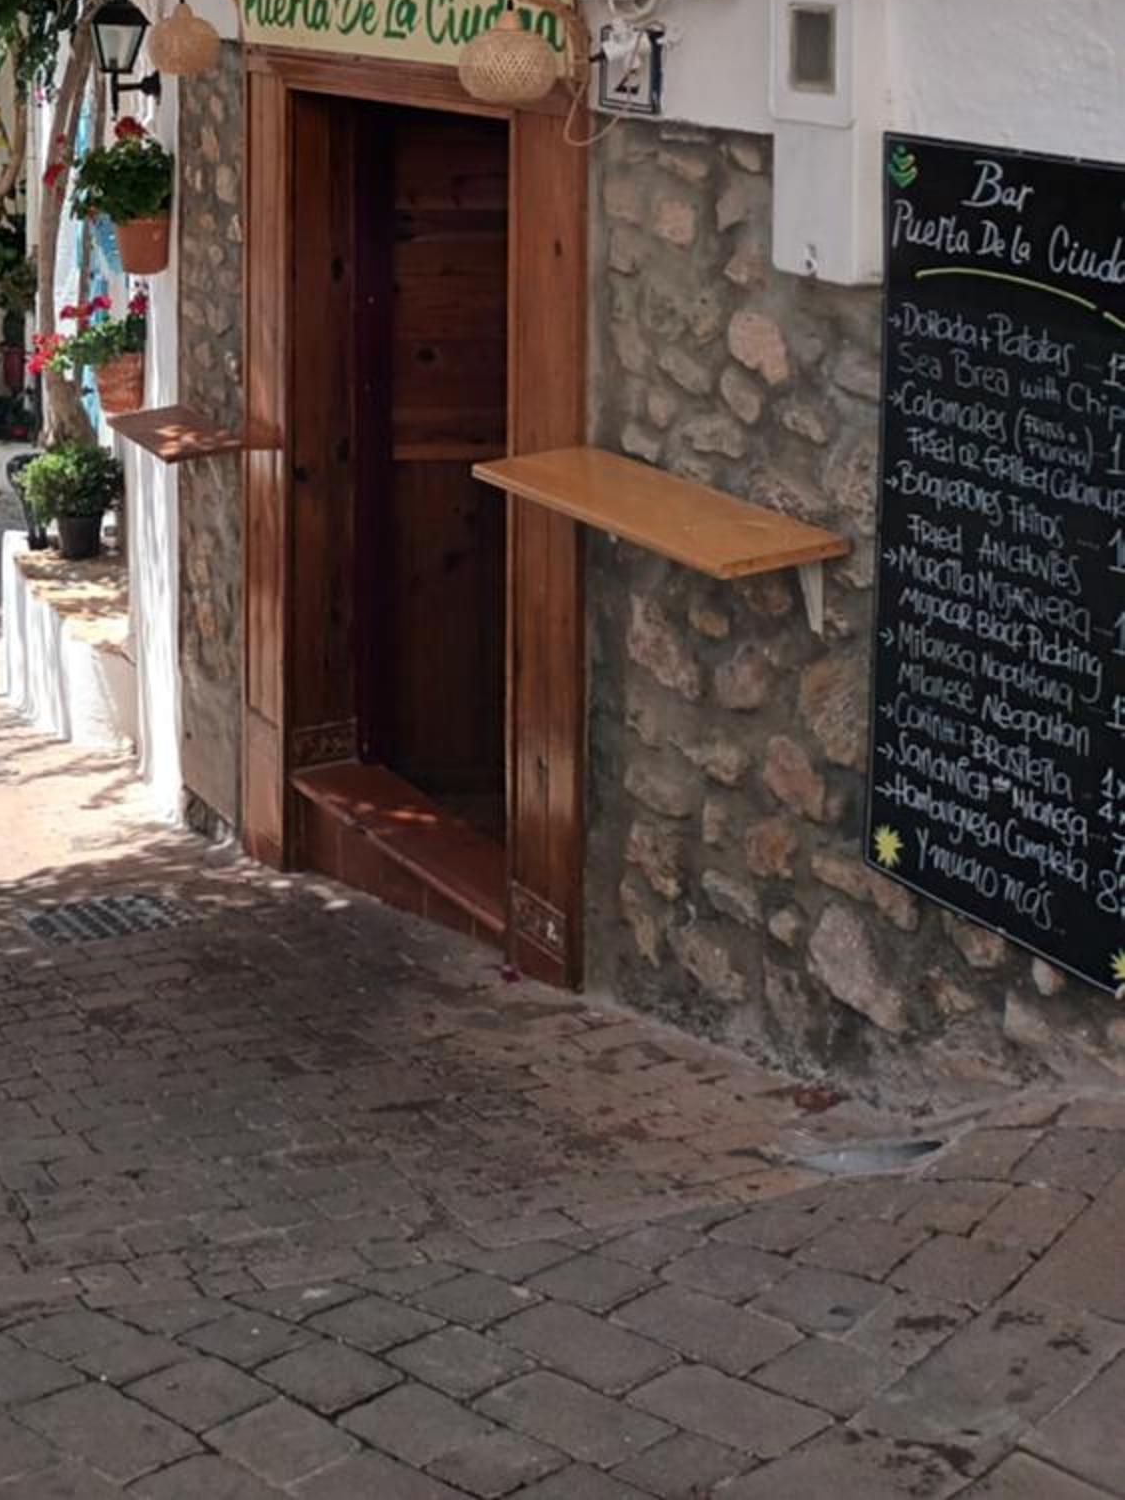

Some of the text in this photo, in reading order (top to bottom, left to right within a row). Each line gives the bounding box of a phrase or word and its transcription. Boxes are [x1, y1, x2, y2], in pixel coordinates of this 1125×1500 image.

[961, 159, 1034, 214] Bar
[891, 199, 970, 255] Puerta
[977, 219, 1007, 258] De
[897, 341, 942, 381] Sea
[952, 348, 1009, 398] Brea
[1020, 375, 1062, 405] with
[915, 825, 935, 871] Y
